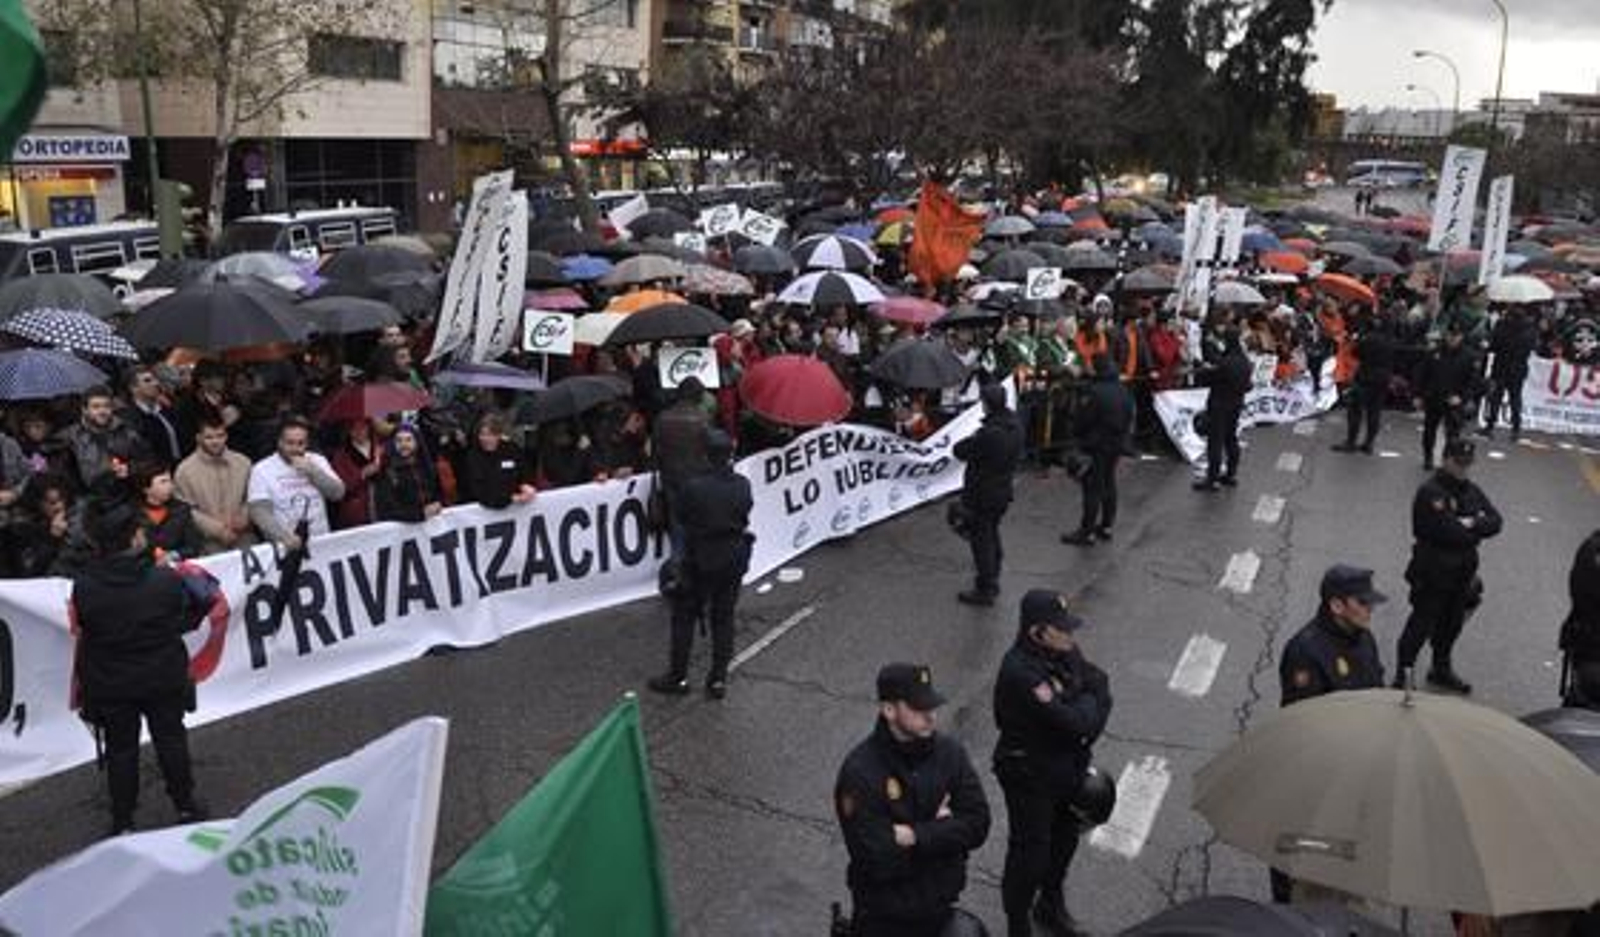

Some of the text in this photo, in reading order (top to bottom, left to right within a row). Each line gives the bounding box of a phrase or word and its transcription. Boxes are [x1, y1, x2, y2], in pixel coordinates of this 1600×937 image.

[19, 138, 126, 156] ORTOPEDIA
[783, 477, 821, 516] LO
[241, 549, 266, 586] A
